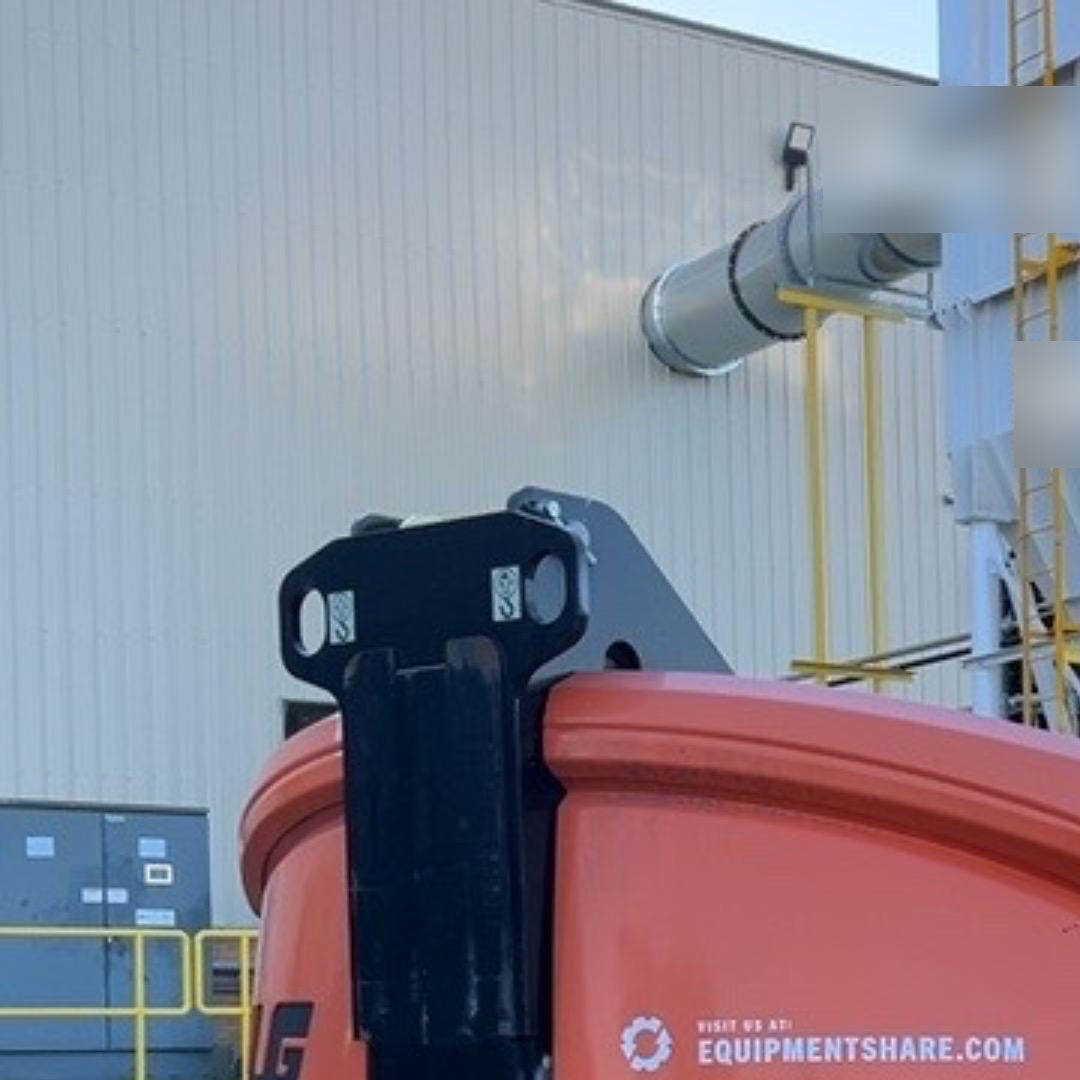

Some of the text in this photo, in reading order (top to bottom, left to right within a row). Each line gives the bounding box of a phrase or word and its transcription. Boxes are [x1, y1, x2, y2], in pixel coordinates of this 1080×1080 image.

[697, 1019, 737, 1033] VISIT
[743, 1019, 763, 1032] US
[698, 1035, 1026, 1066] EQUIPMENTSHARE.COM
